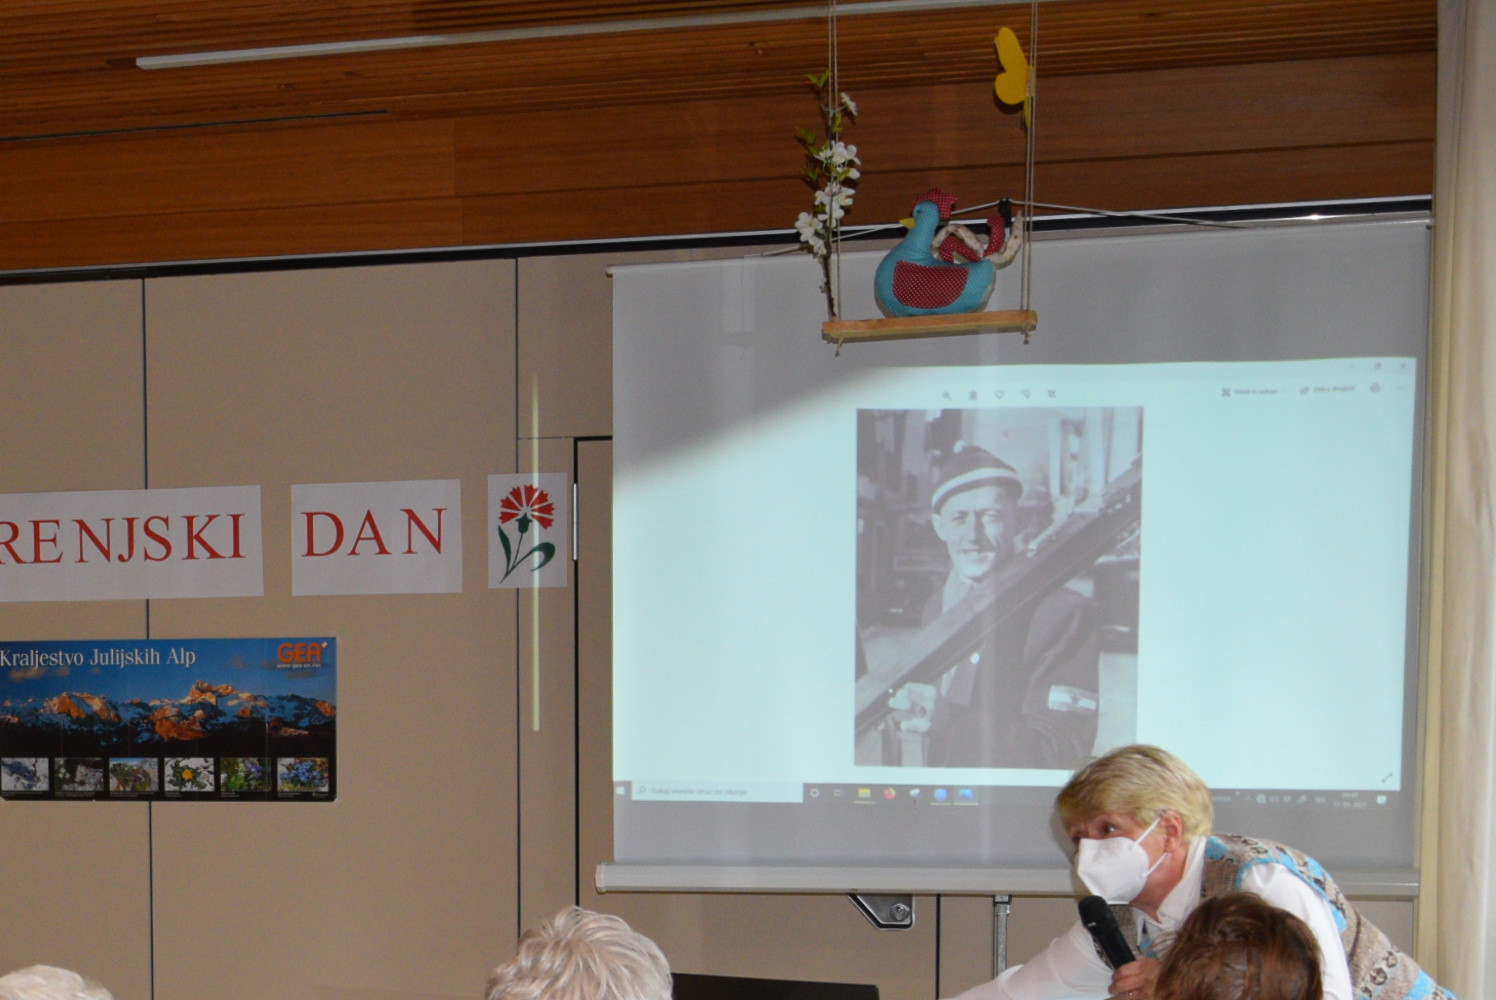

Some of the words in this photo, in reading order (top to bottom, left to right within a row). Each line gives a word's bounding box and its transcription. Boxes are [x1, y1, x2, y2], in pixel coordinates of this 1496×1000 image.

[301, 508, 447, 557] DAN
[0, 649, 84, 669] Kraljestvo
[90, 648, 160, 668] Julijskih
[166, 648, 196, 668] Alp
[277, 642, 322, 663] GEA
